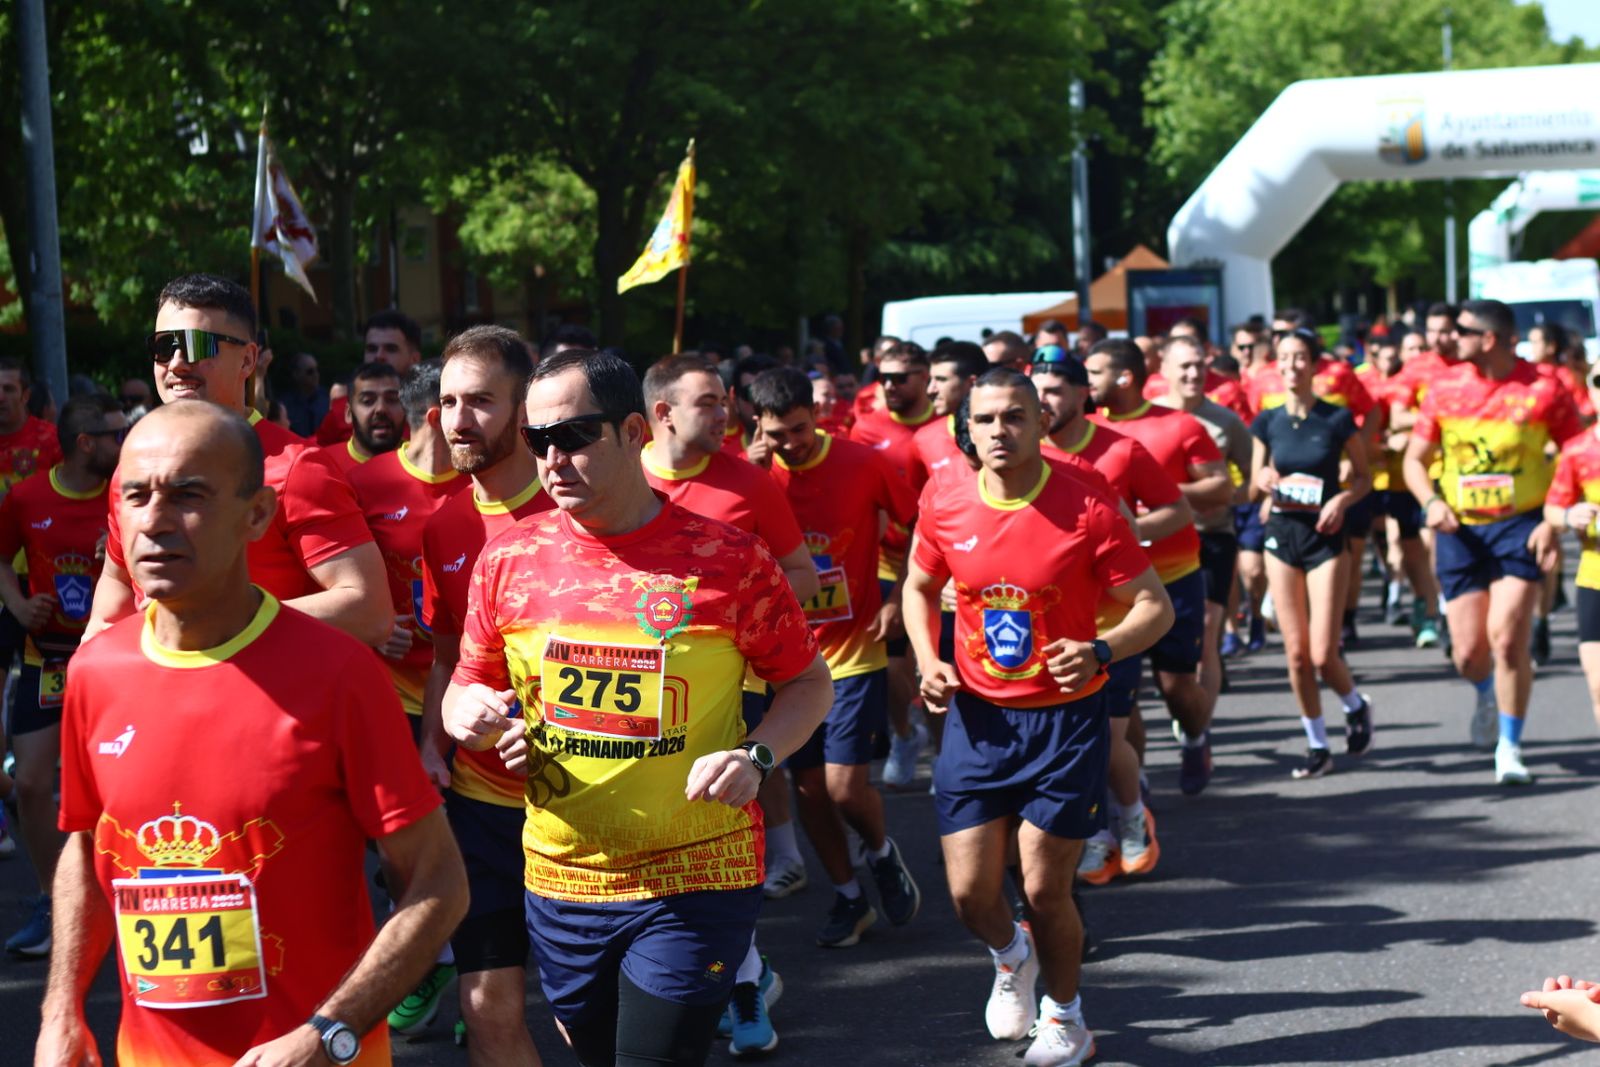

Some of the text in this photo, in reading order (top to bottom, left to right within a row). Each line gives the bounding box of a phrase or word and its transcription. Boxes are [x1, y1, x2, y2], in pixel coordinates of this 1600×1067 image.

[1441, 137, 1597, 159] de Salamanca
[801, 585, 836, 609] 17
[546, 640, 660, 661] XIV SAN FERNANDO
[573, 653, 628, 668] CARRERA
[51, 672, 65, 693] 3
[558, 666, 642, 713] 275
[565, 737, 645, 760] FERNANDO
[648, 735, 687, 758] 2026
[687, 846, 725, 862] TRABAJO
[656, 865, 684, 874] VALOR
[643, 878, 662, 890] POR
[666, 876, 677, 888] EL
[681, 872, 722, 886] TRABAJO
[118, 887, 140, 911] XIV
[142, 895, 209, 913] CARRERA
[134, 914, 227, 971] 341
